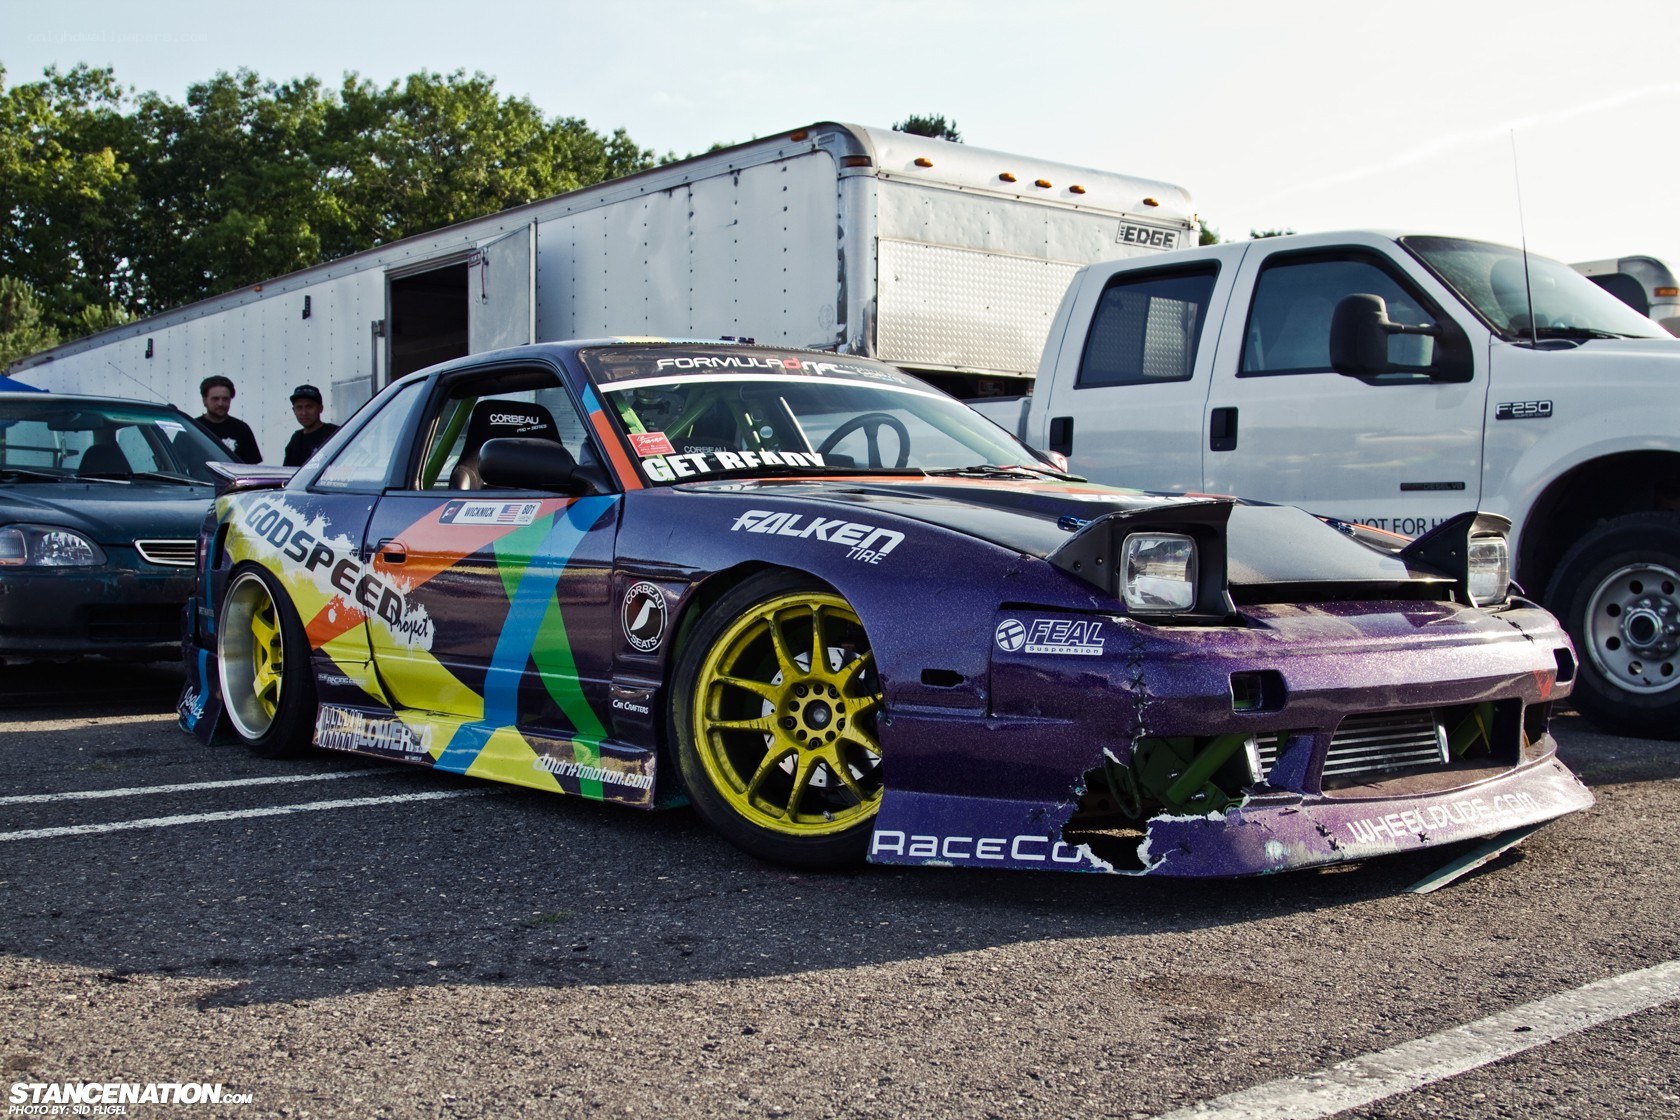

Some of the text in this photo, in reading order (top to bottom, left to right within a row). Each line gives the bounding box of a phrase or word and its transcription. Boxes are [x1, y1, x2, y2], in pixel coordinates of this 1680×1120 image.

[1123, 226, 1175, 249] EDGE
[489, 414, 539, 425] CORBEAU
[641, 452, 712, 482] GET
[1393, 517, 1427, 535] FOR
[245, 502, 402, 625] GODSPEED
[846, 546, 888, 565] TIRE
[626, 584, 664, 609] CORBEAU
[630, 634, 657, 649] SEATS
[1025, 619, 1105, 647] FEAL
[1029, 645, 1099, 655] Suspension
[1346, 791, 1541, 844] WHEELDUDE.COM
